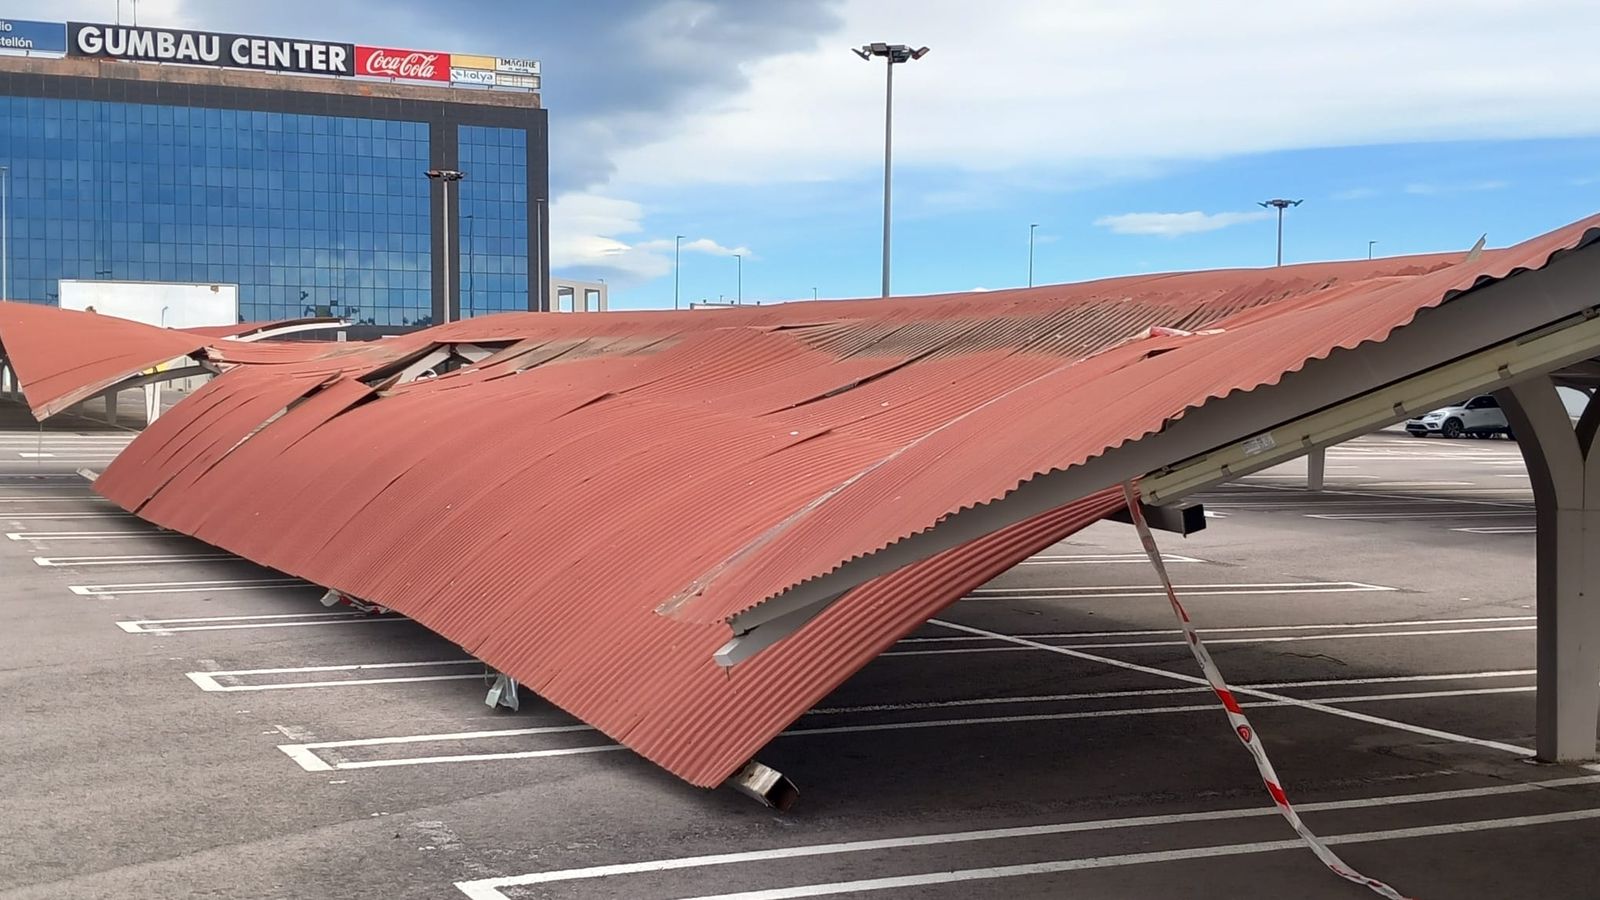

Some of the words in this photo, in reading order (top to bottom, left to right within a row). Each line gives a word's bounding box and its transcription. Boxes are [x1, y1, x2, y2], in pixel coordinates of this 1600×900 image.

[77, 26, 220, 62] GUMBAU
[231, 37, 347, 72] CENTER
[366, 49, 439, 78] Coca-Cola
[500, 58, 536, 69] IMAGINE
[463, 70, 493, 81] kolya
